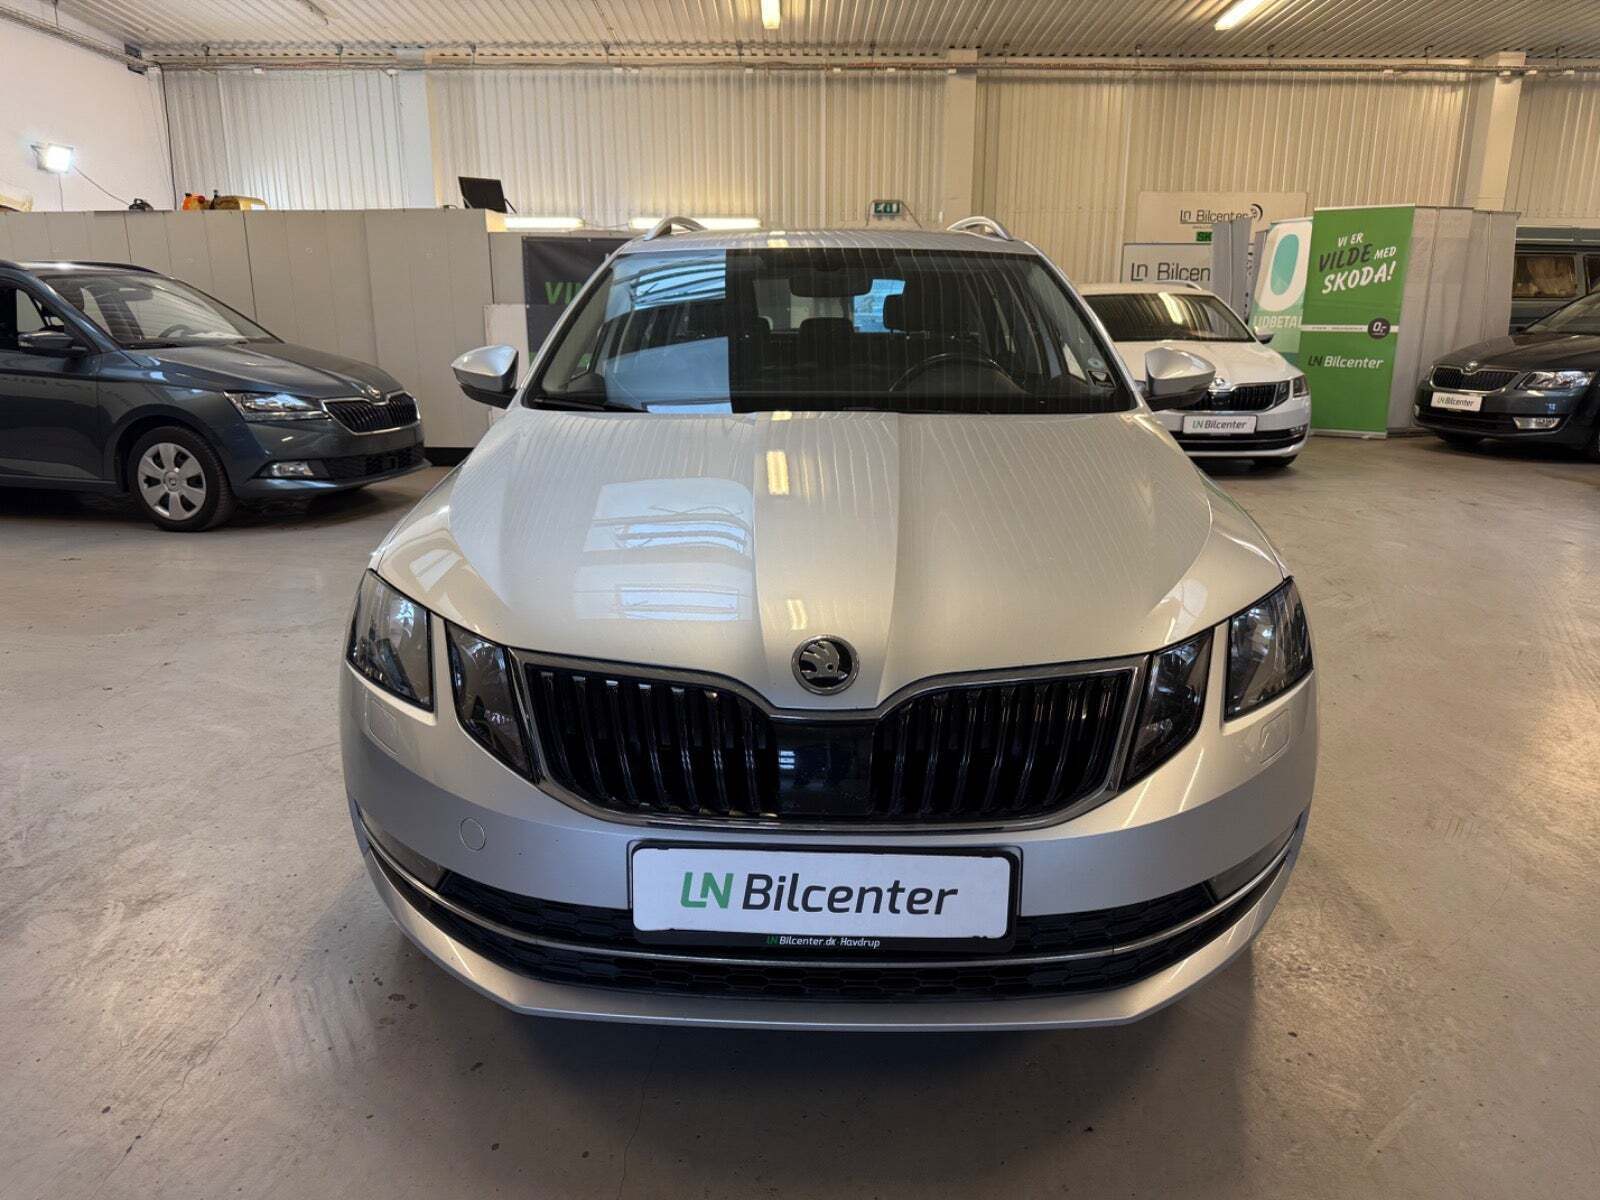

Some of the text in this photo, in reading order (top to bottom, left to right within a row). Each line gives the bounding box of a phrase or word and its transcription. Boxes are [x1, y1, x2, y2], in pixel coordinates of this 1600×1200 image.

[1338, 232, 1364, 247] VI ER
[1318, 243, 1397, 272] VILDE MED
[1321, 260, 1397, 294] SKODA!
[1324, 355, 1384, 369] Bilcenter
[1204, 420, 1247, 429] Bilcenter
[680, 871, 959, 915] LN Bilcenter
